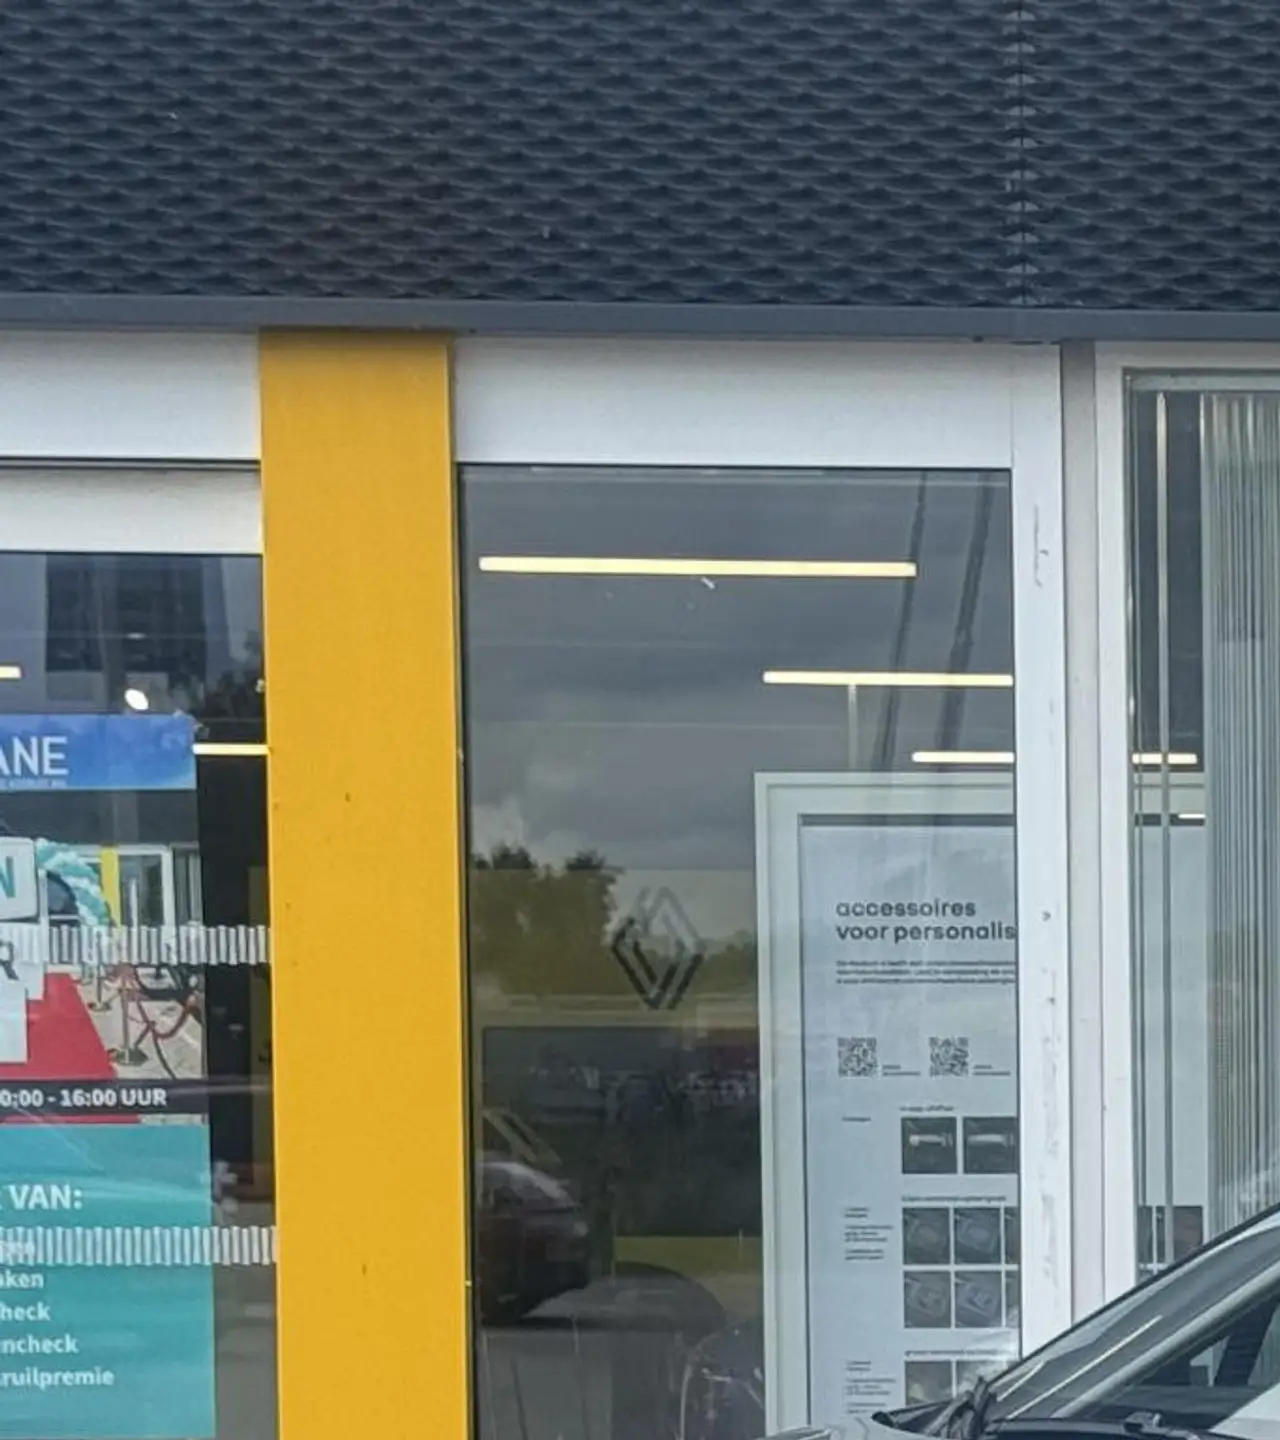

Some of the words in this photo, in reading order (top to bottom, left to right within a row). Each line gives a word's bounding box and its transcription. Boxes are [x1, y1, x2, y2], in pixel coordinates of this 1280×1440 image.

[836, 899, 976, 918] accessoires
[836, 925, 888, 940] voor
[60, 1088, 117, 1107] 16:00
[121, 1088, 167, 1106] UUR
[8, 1184, 82, 1210] VAN:
